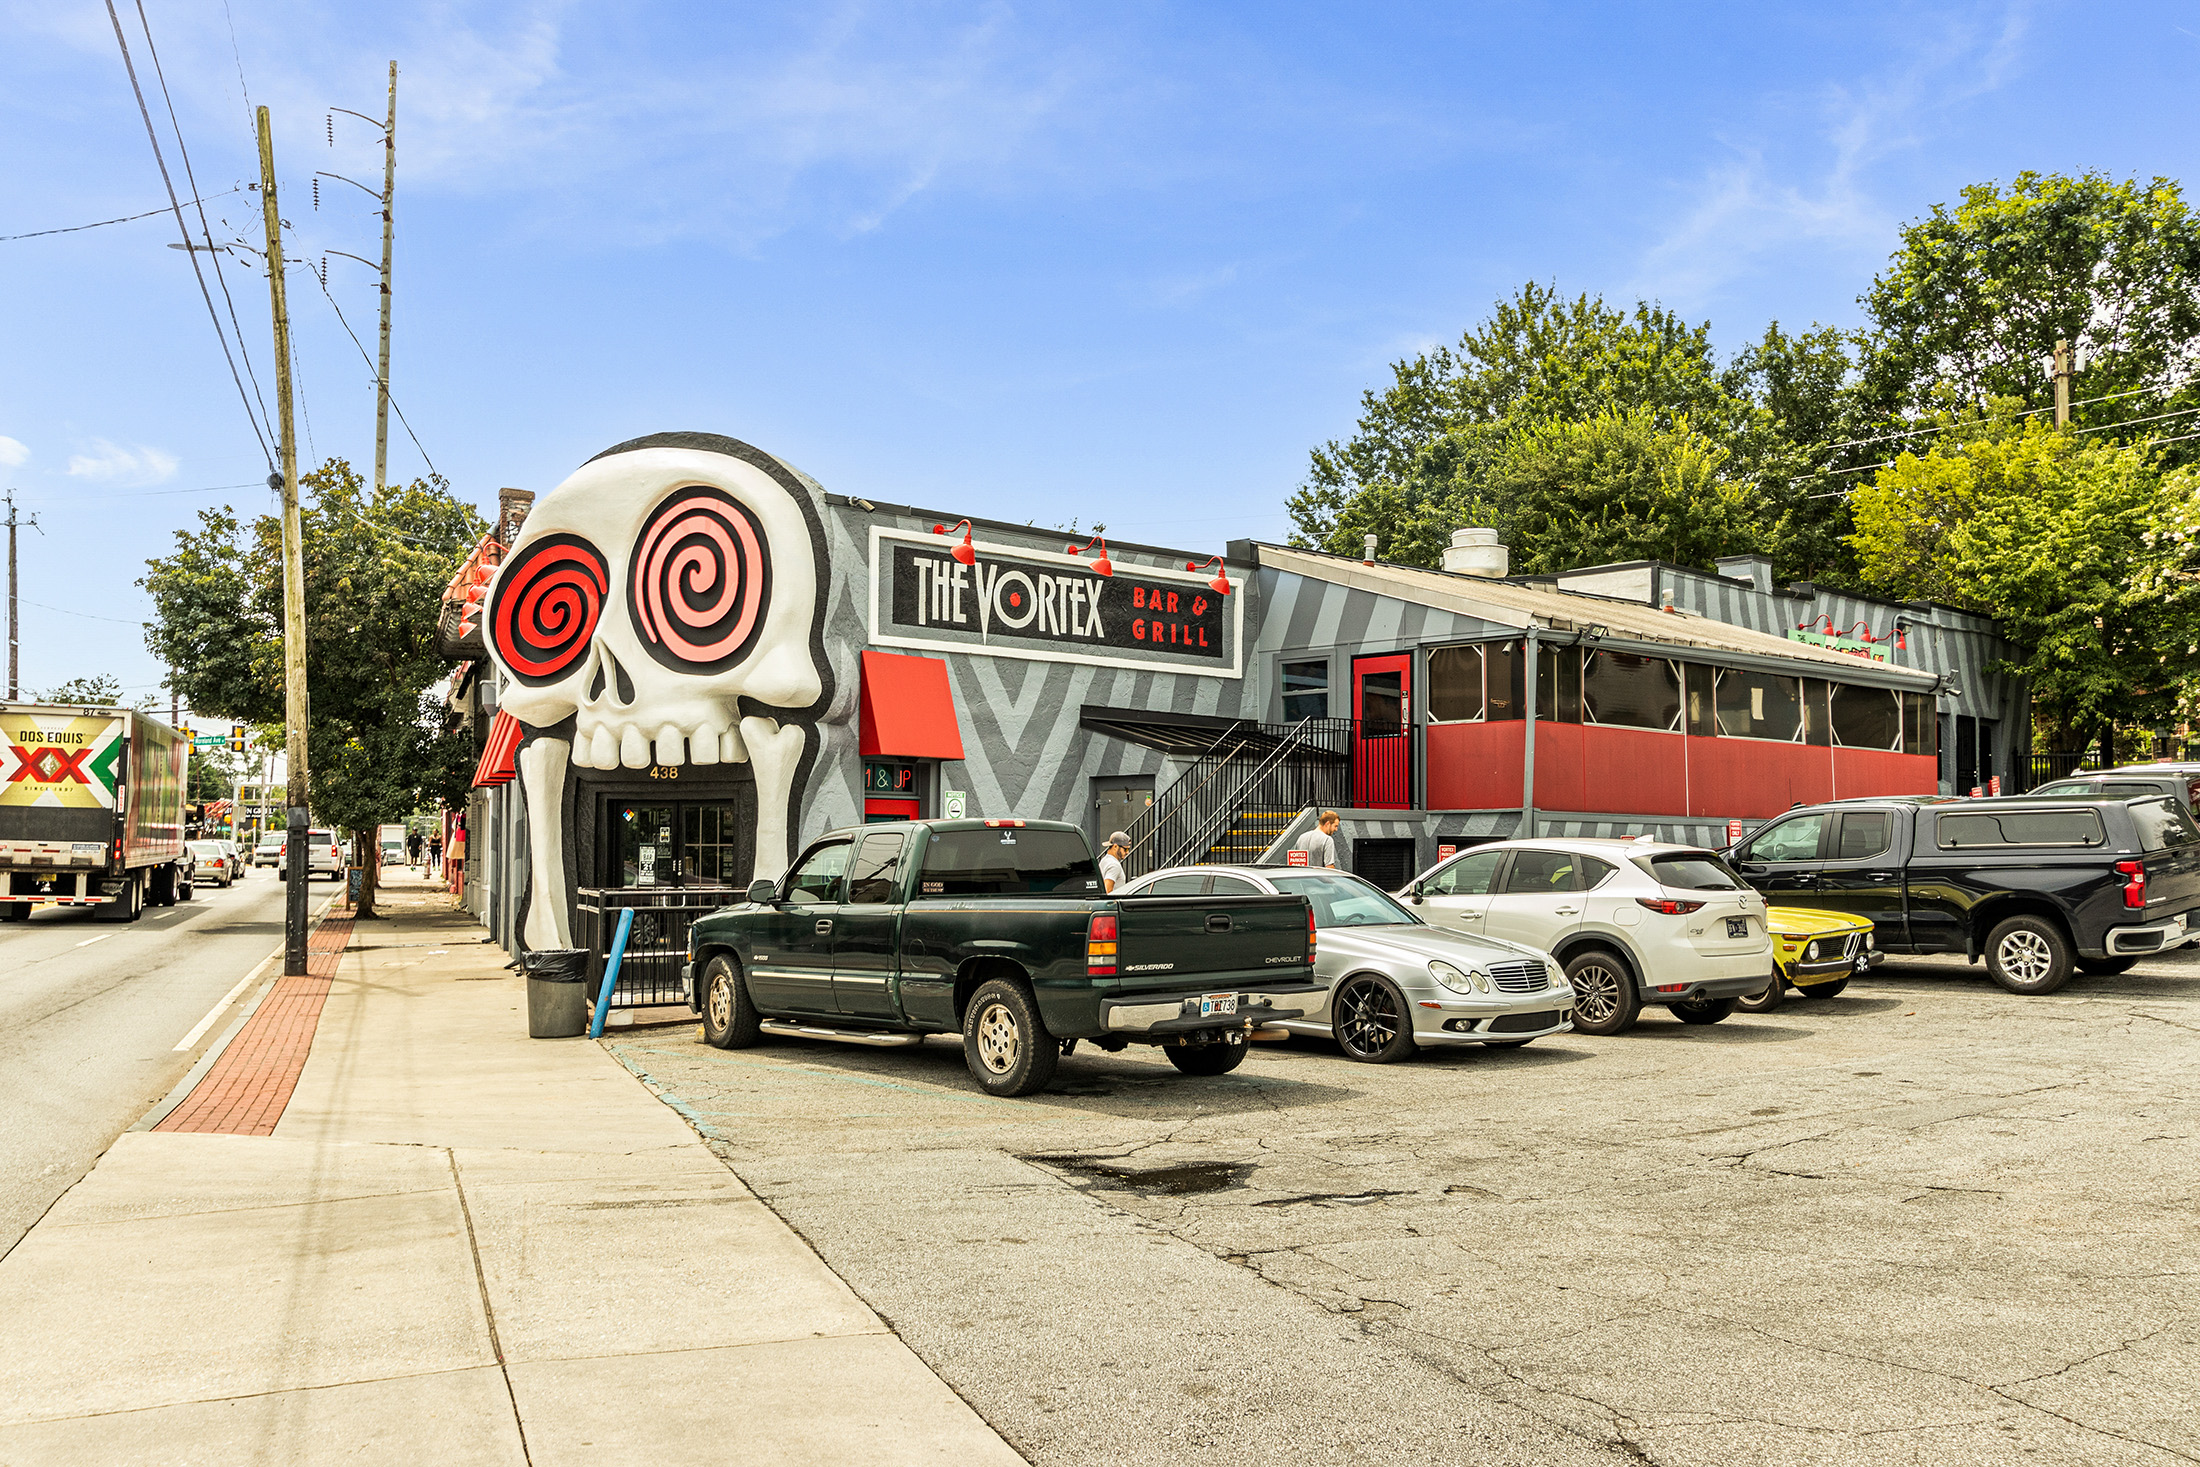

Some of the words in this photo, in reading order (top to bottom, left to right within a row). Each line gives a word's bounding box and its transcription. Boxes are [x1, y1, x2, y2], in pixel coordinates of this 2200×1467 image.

[914, 557, 969, 625] THE
[975, 563, 1104, 645] VORTEX
[1133, 587, 1178, 613] BAR
[1192, 595, 1208, 616] &
[1132, 618, 1208, 647] GRILL
[83, 707, 96, 717] 87
[20, 730, 44, 743] DOS
[47, 732, 83, 744] EQUIS
[650, 766, 678, 779] 438
[876, 769, 889, 788] &
[894, 770, 912, 788] JP
[1134, 963, 1174, 971] SILVERADO
[1265, 956, 1301, 964] CHEVROLET
